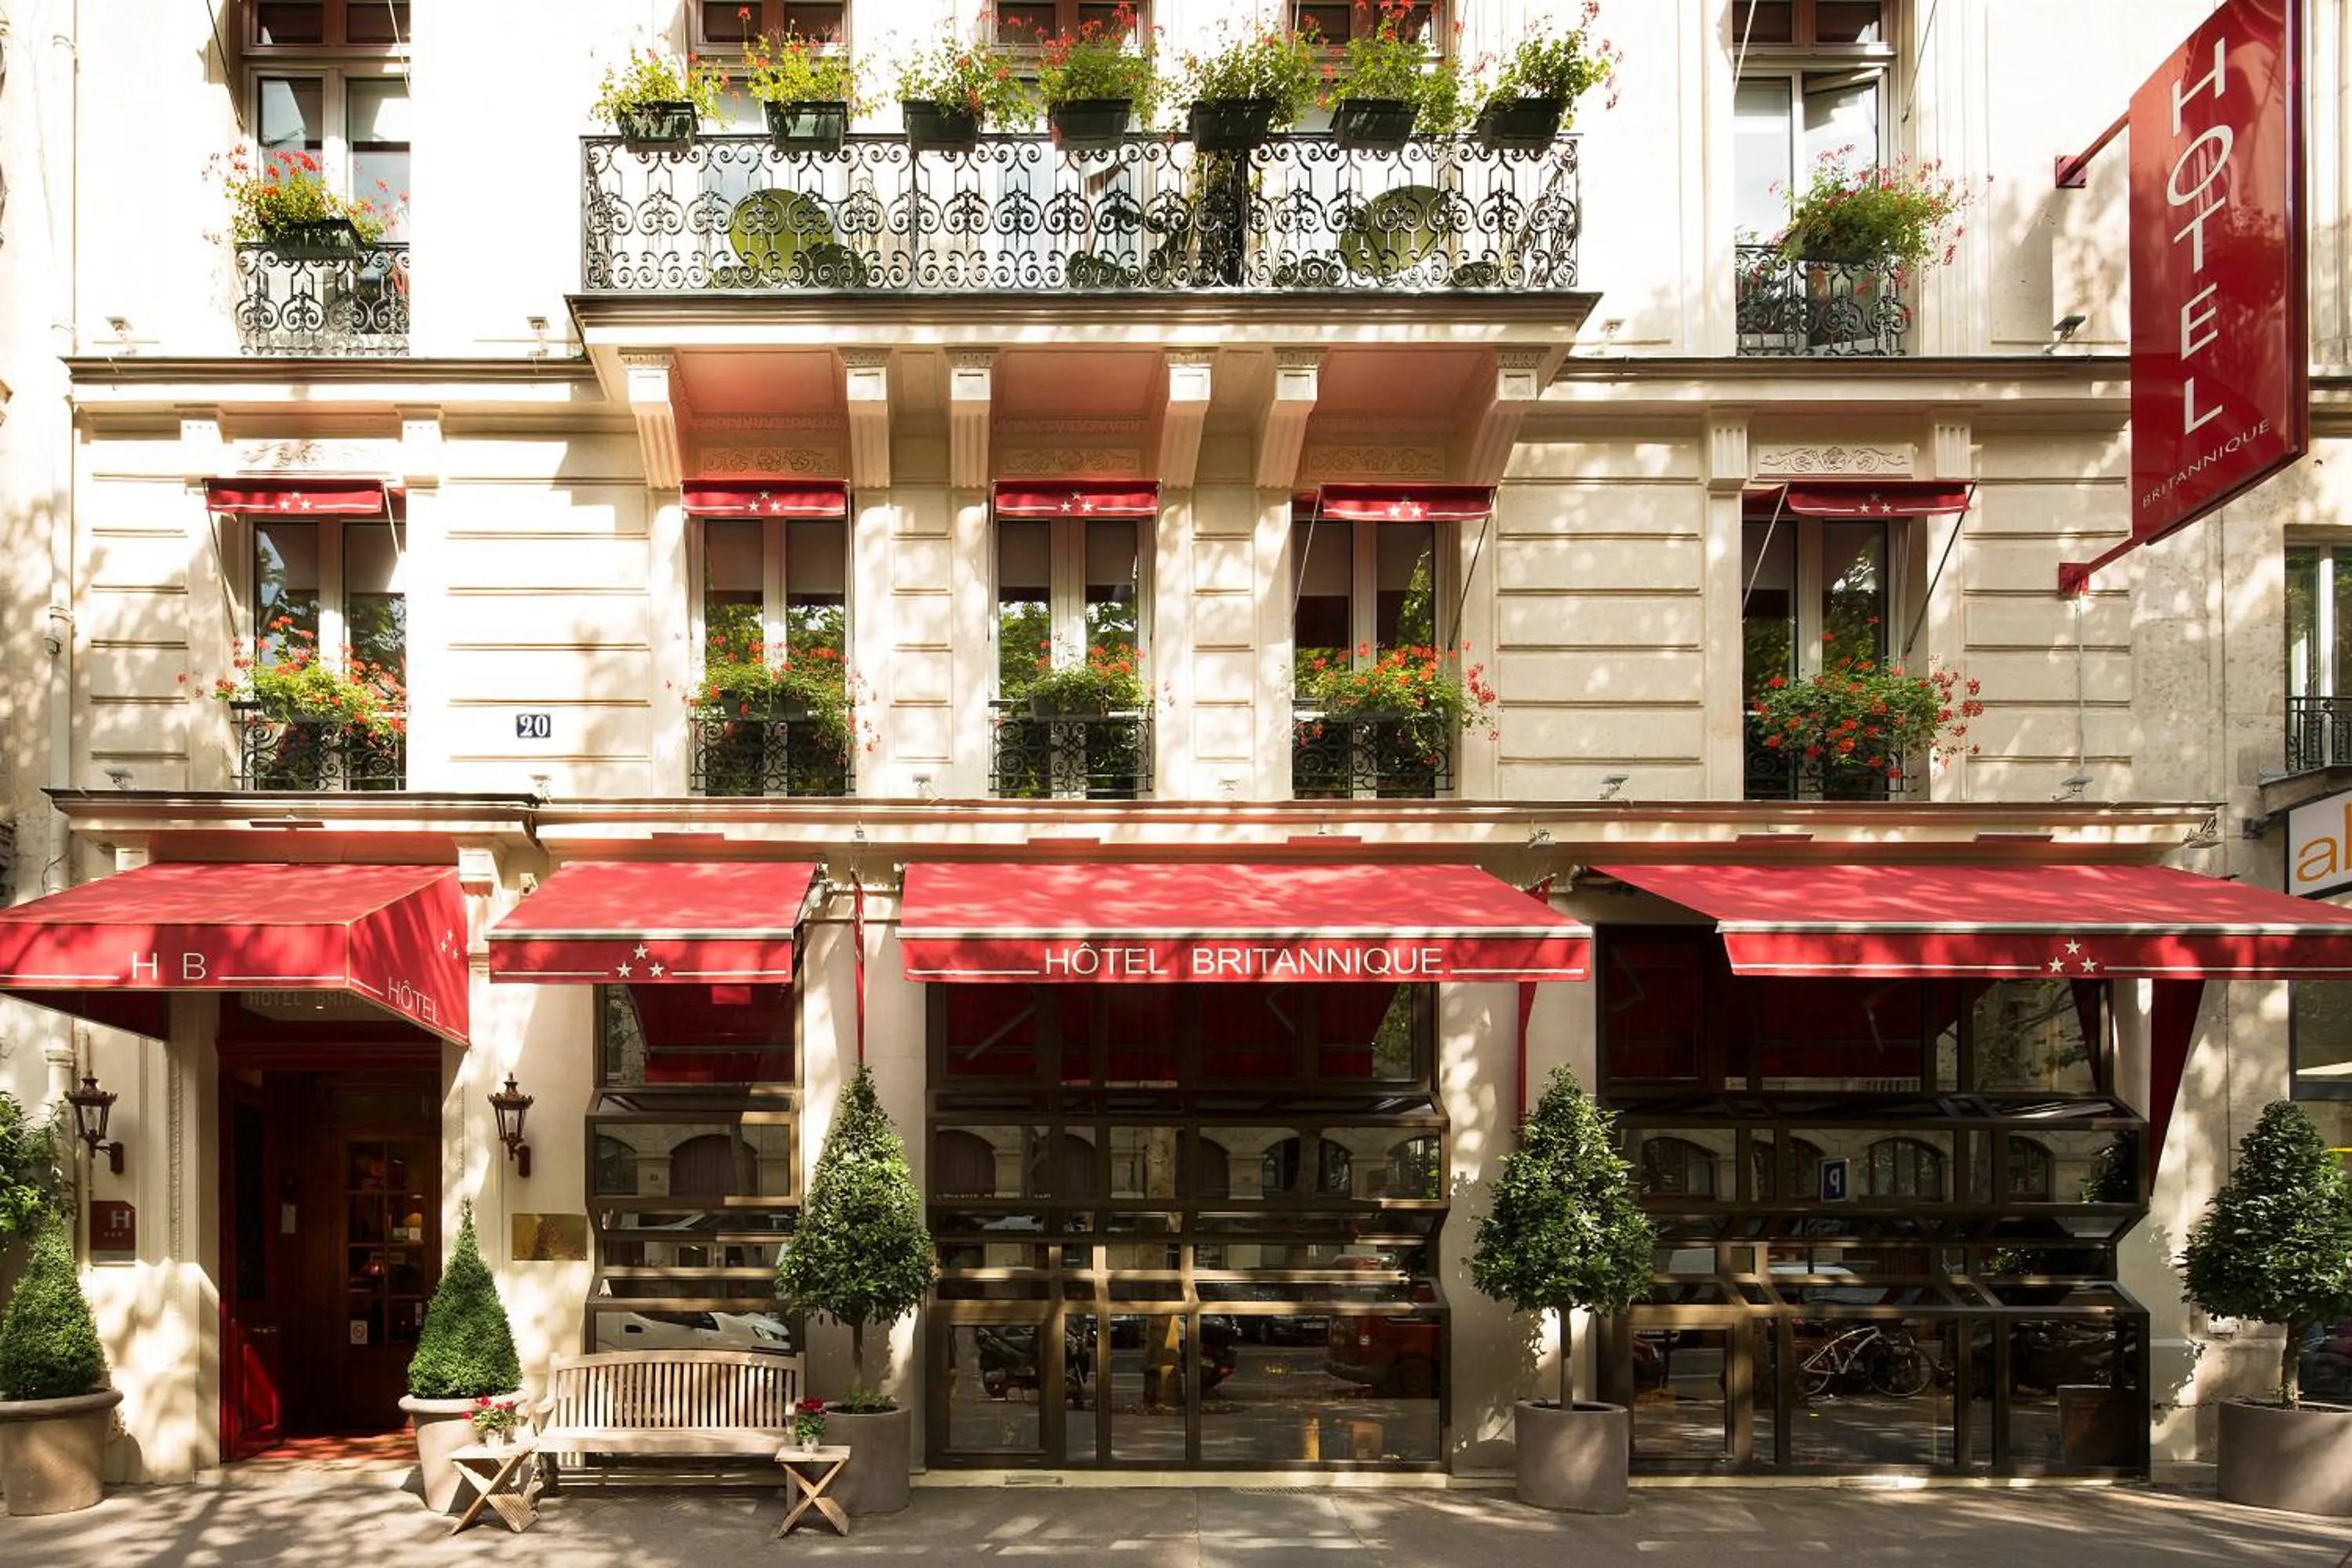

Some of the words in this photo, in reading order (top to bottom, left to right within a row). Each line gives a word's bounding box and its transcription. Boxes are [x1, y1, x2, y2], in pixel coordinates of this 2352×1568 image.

[2165, 37, 2234, 436] HOTEL
[2142, 418, 2270, 509] BRITANNIQUE
[520, 714, 548, 738] 20
[132, 952, 158, 979] H
[183, 952, 207, 979] B
[1045, 942, 1167, 975] HÔTEL
[1192, 947, 1443, 976] BRITANNIQUE
[388, 977, 441, 1026] HÔTEL
[111, 1210, 130, 1229] H
